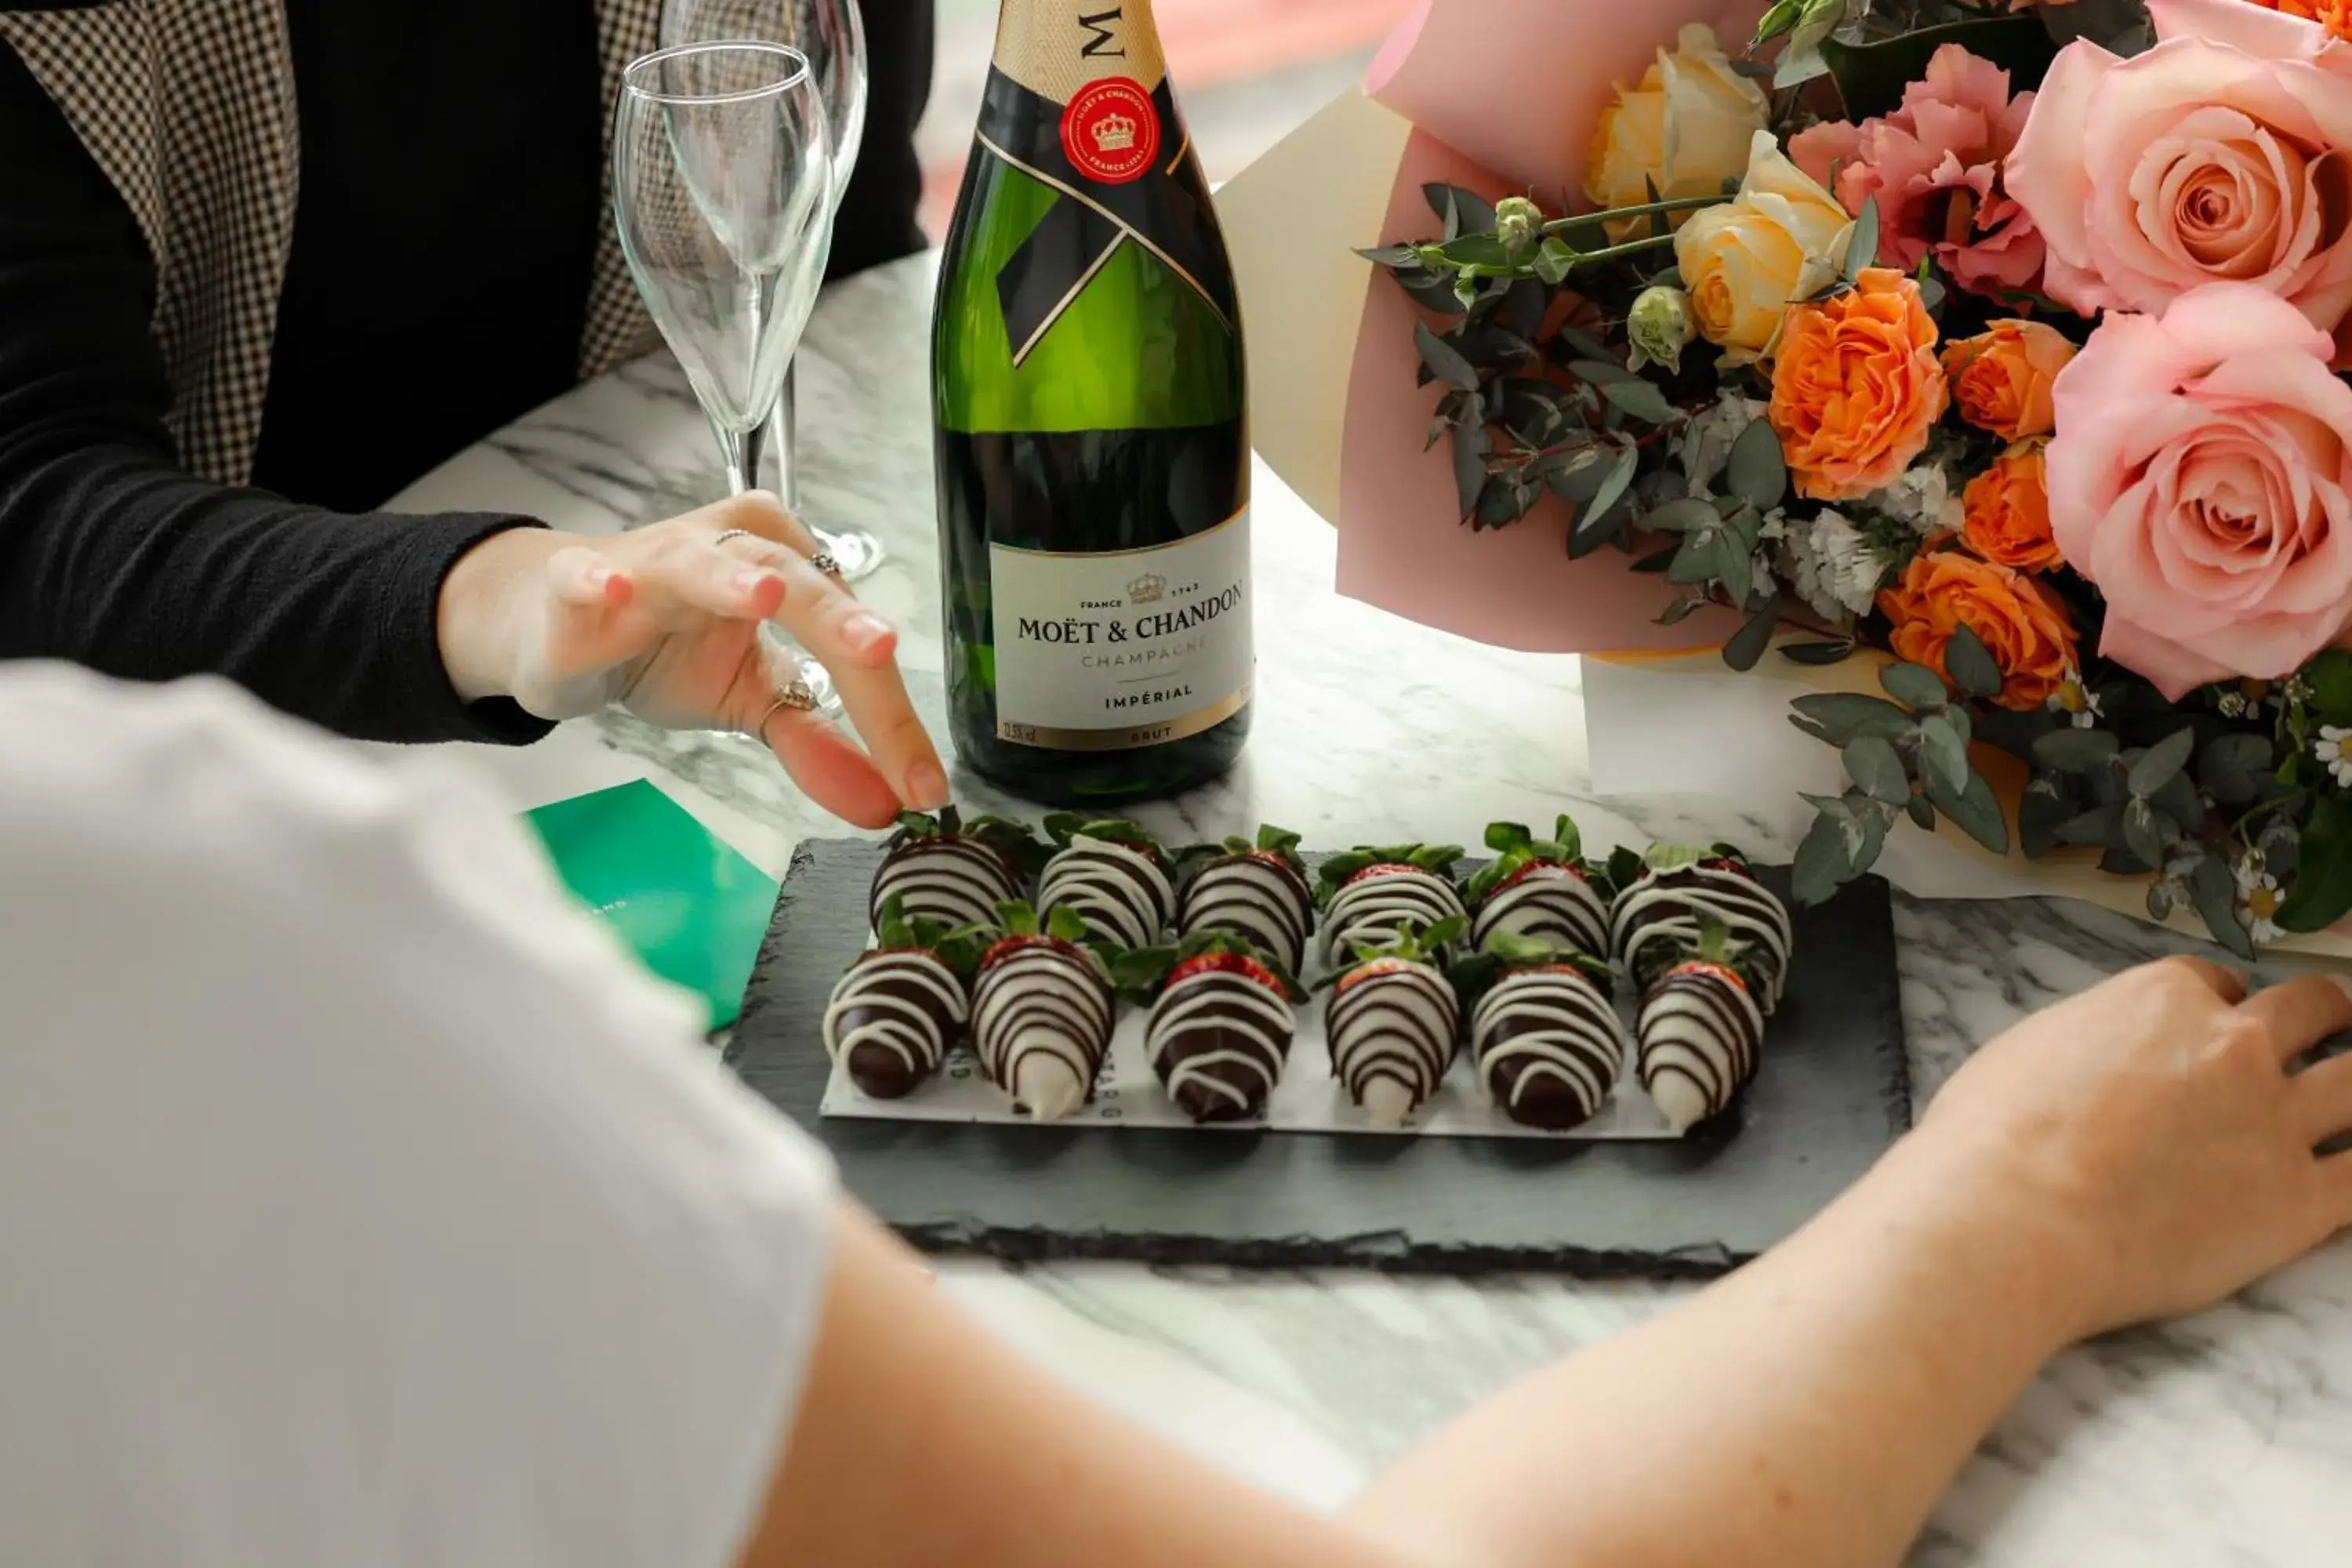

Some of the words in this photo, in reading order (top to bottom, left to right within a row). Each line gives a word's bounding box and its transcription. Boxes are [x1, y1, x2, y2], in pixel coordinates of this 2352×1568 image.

[1018, 617, 1099, 644] MOËT
[1108, 620, 1127, 642] &
[1136, 580, 1242, 639] CHANDON
[1080, 600, 1122, 609] FRANCE
[1082, 635, 1206, 667] CHAMPAGNE
[1105, 684, 1192, 709] IMPÉRIAL
[1131, 727, 1171, 742] BRUT
